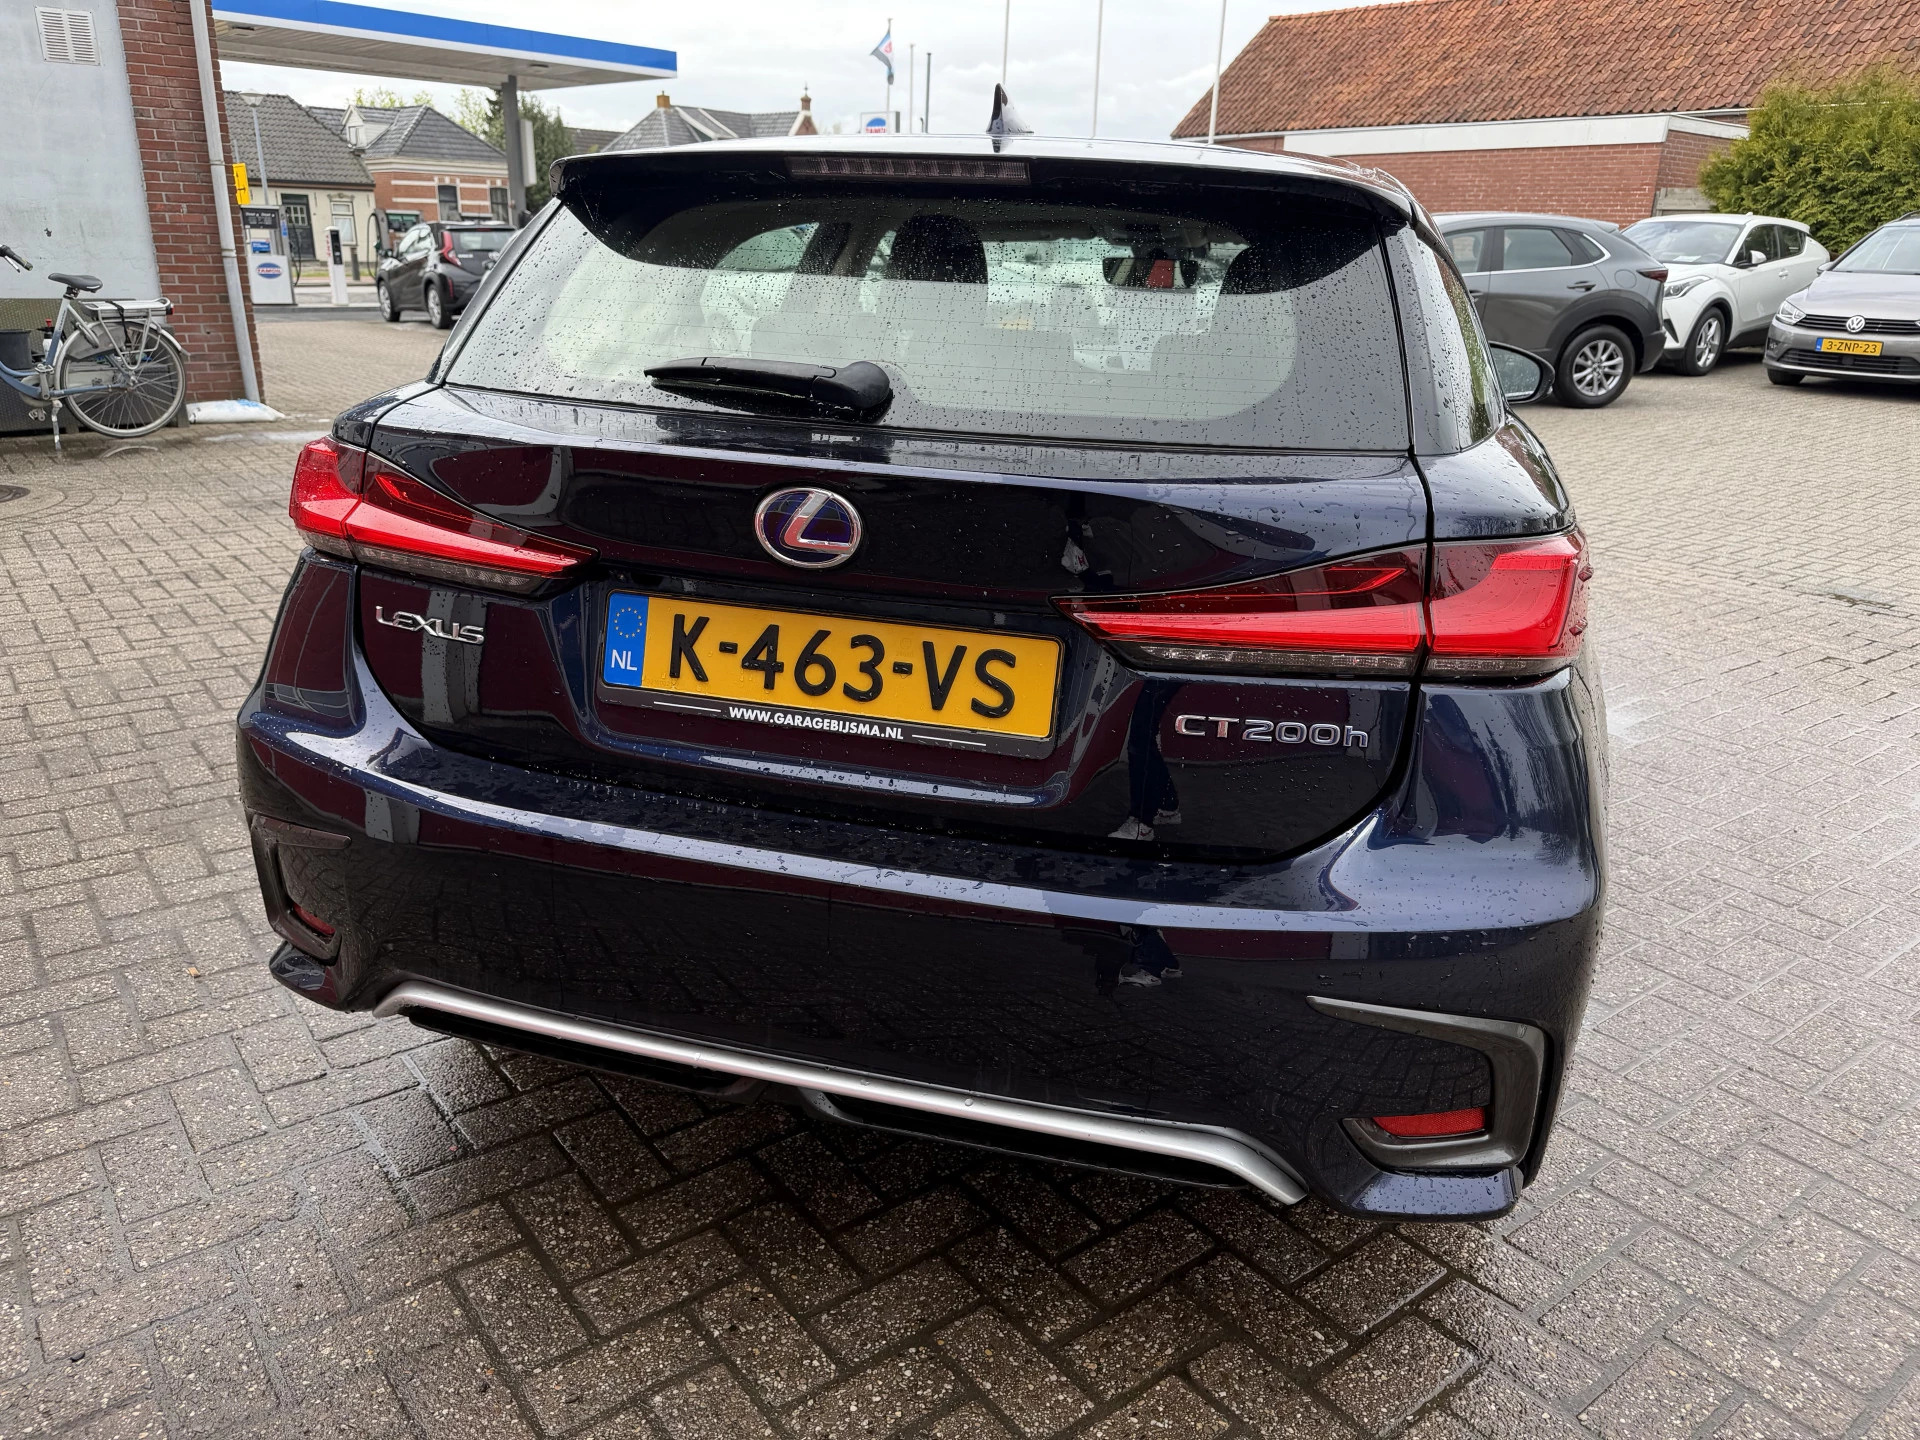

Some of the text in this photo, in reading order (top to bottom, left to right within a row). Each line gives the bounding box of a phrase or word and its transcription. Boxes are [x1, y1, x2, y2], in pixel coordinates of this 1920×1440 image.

[1826, 340, 1878, 354] 3-ZNP-23
[375, 605, 485, 645] LEXUS
[610, 649, 638, 671] NL
[669, 613, 1017, 719] K-463-VS
[728, 706, 904, 740] WWW.GARAGEBIJSMA.NL
